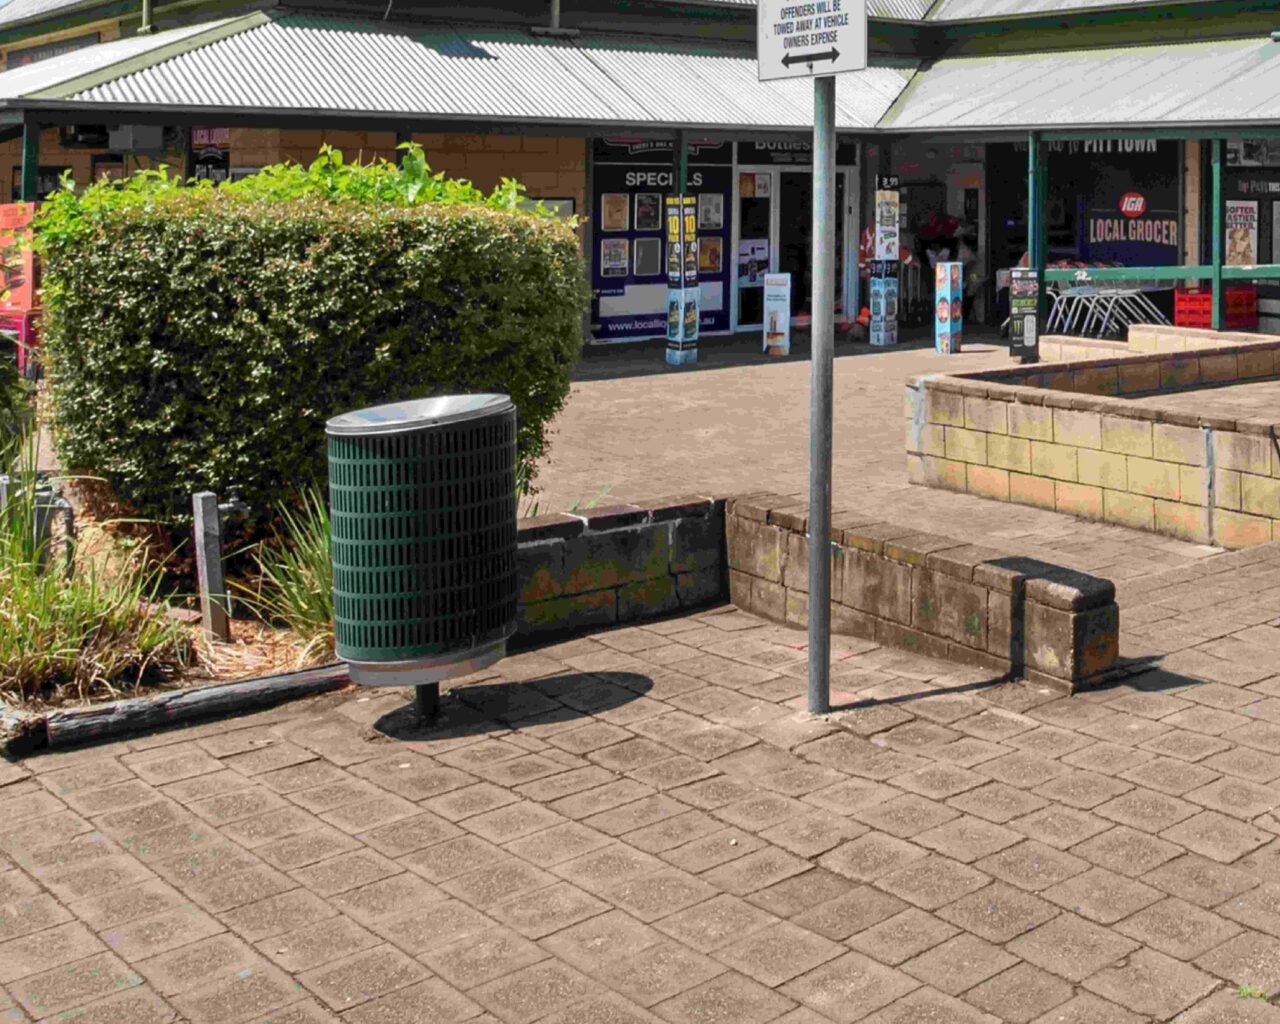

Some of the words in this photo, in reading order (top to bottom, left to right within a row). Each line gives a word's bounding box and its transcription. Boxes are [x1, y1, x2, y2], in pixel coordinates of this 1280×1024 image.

[780, 3, 816, 20] OFFENDERS
[816, 1, 832, 13] WILL
[773, 23, 795, 36] TOWED
[795, 20, 814, 33] AWAY
[814, 18, 823, 29] AT
[823, 13, 849, 28] VEHICLE
[783, 35, 810, 50] OWNERS
[810, 30, 838, 45] EXPENSE
[625, 172, 703, 186] SPECIS
[1121, 196, 1145, 212] IGA
[1089, 218, 1127, 244] LOCAL
[1128, 219, 1178, 246] GROCER
